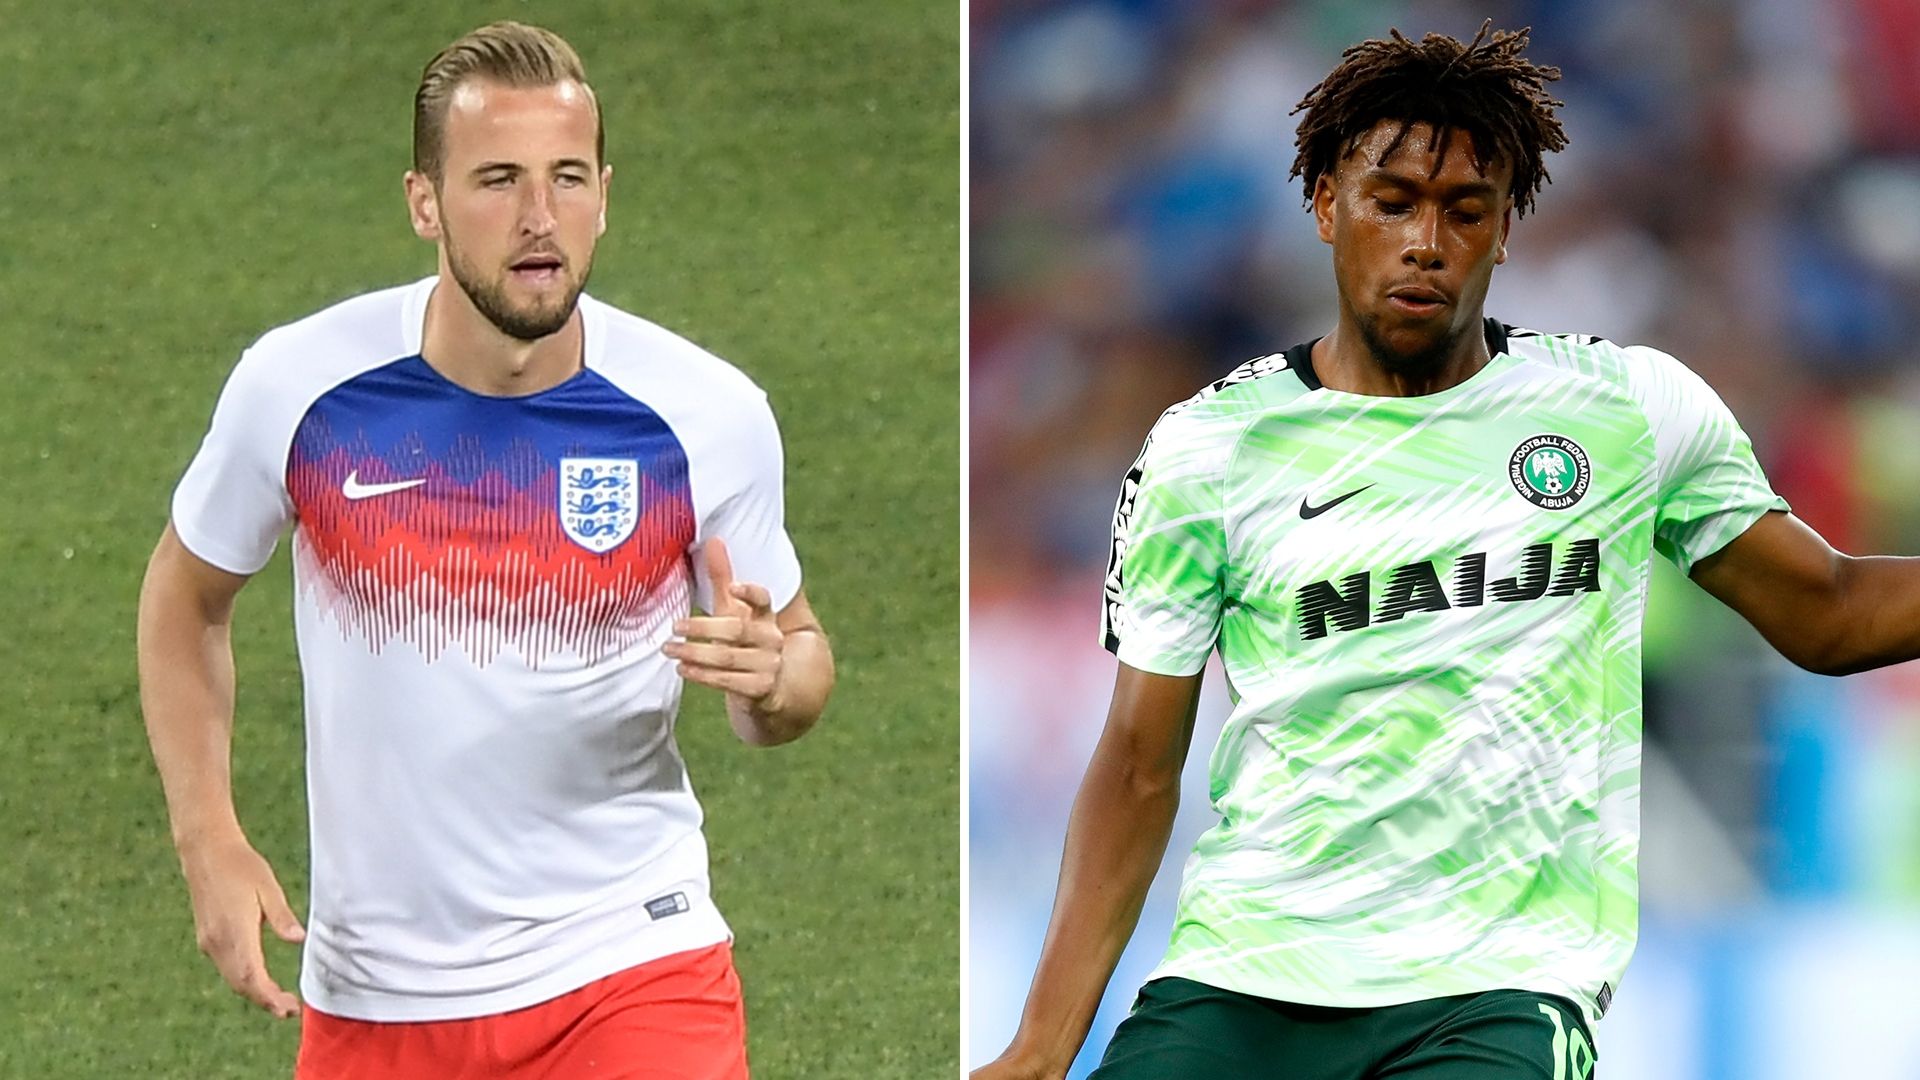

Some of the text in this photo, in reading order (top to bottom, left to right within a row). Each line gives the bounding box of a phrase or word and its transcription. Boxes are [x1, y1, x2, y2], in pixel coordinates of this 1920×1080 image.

[1511, 436, 1589, 499] NIGERIA FOOTBALL FEDERATION
[1539, 496, 1574, 508] ABUJA
[1295, 538, 1602, 641] NAIJA
